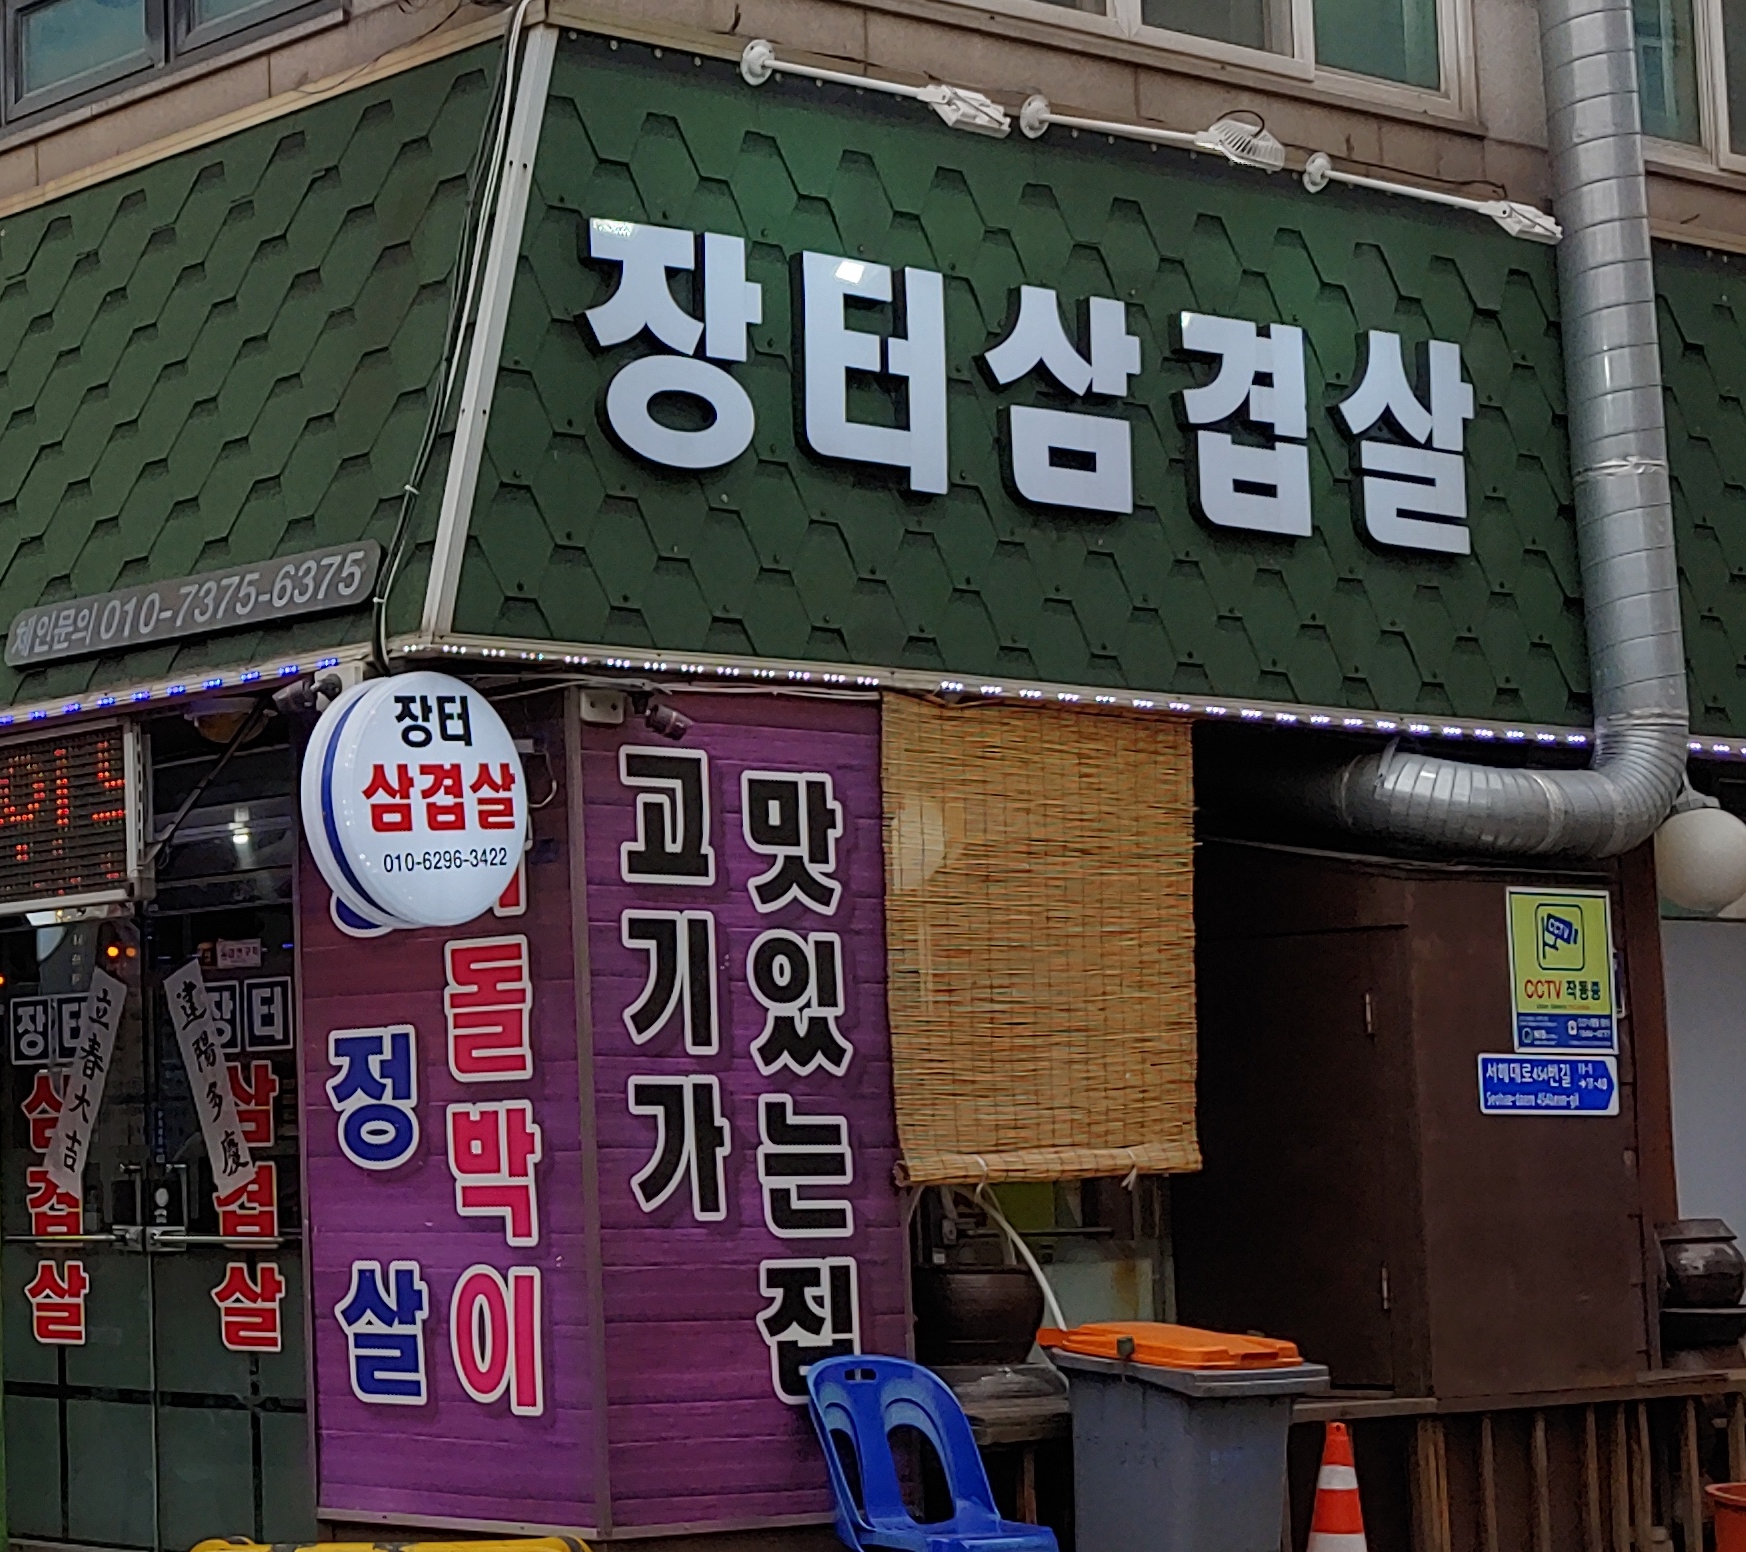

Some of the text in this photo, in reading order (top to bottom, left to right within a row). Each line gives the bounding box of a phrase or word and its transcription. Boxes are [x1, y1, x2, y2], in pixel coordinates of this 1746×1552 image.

[100, 550, 366, 641] 010-7375-6375
[394, 694, 474, 748] 장터
[362, 762, 517, 833] 삼겹살
[382, 846, 509, 873] 010-6296-3422
[620, 746, 730, 1221] 고기가
[1524, 979, 1562, 999] CCTV
[63, 988, 113, 1173] 立春大吉
[444, 823, 544, 1416] 돌박이
[327, 888, 430, 1405] 정살
